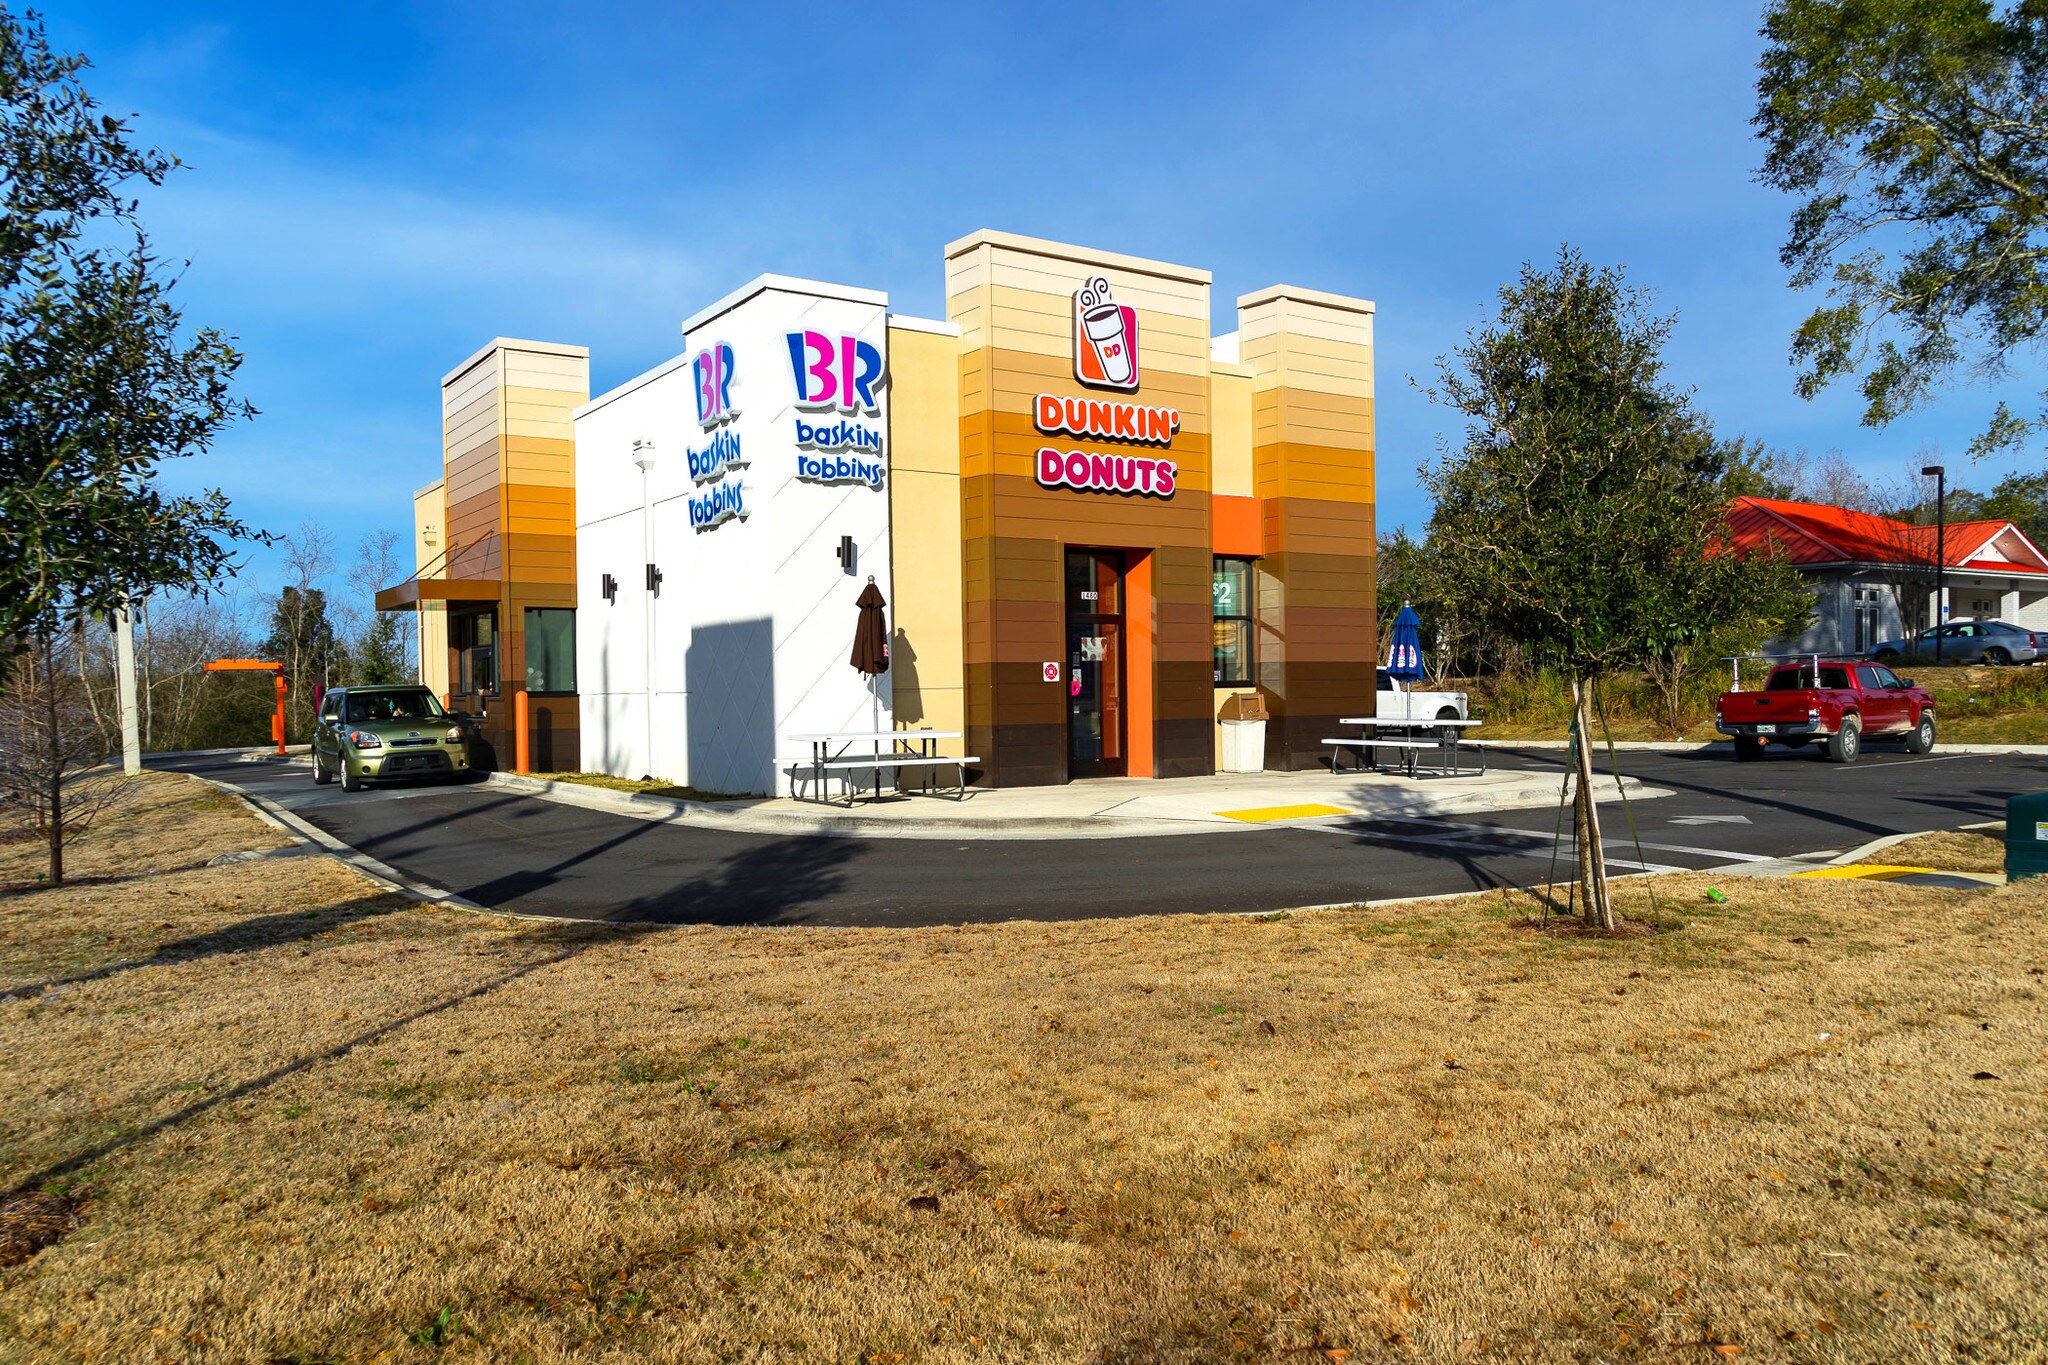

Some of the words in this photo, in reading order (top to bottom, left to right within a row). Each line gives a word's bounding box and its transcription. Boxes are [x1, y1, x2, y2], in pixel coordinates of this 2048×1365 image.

[786, 330, 882, 408] BR
[1103, 343, 1121, 358] DD
[692, 343, 734, 421] BR
[795, 419, 879, 450] baskin
[1040, 395, 1179, 441] DUNKIN'
[687, 429, 741, 479] baskin
[798, 455, 880, 485] robbins
[1041, 449, 1174, 493] DONUTS
[688, 481, 743, 527] robbins
